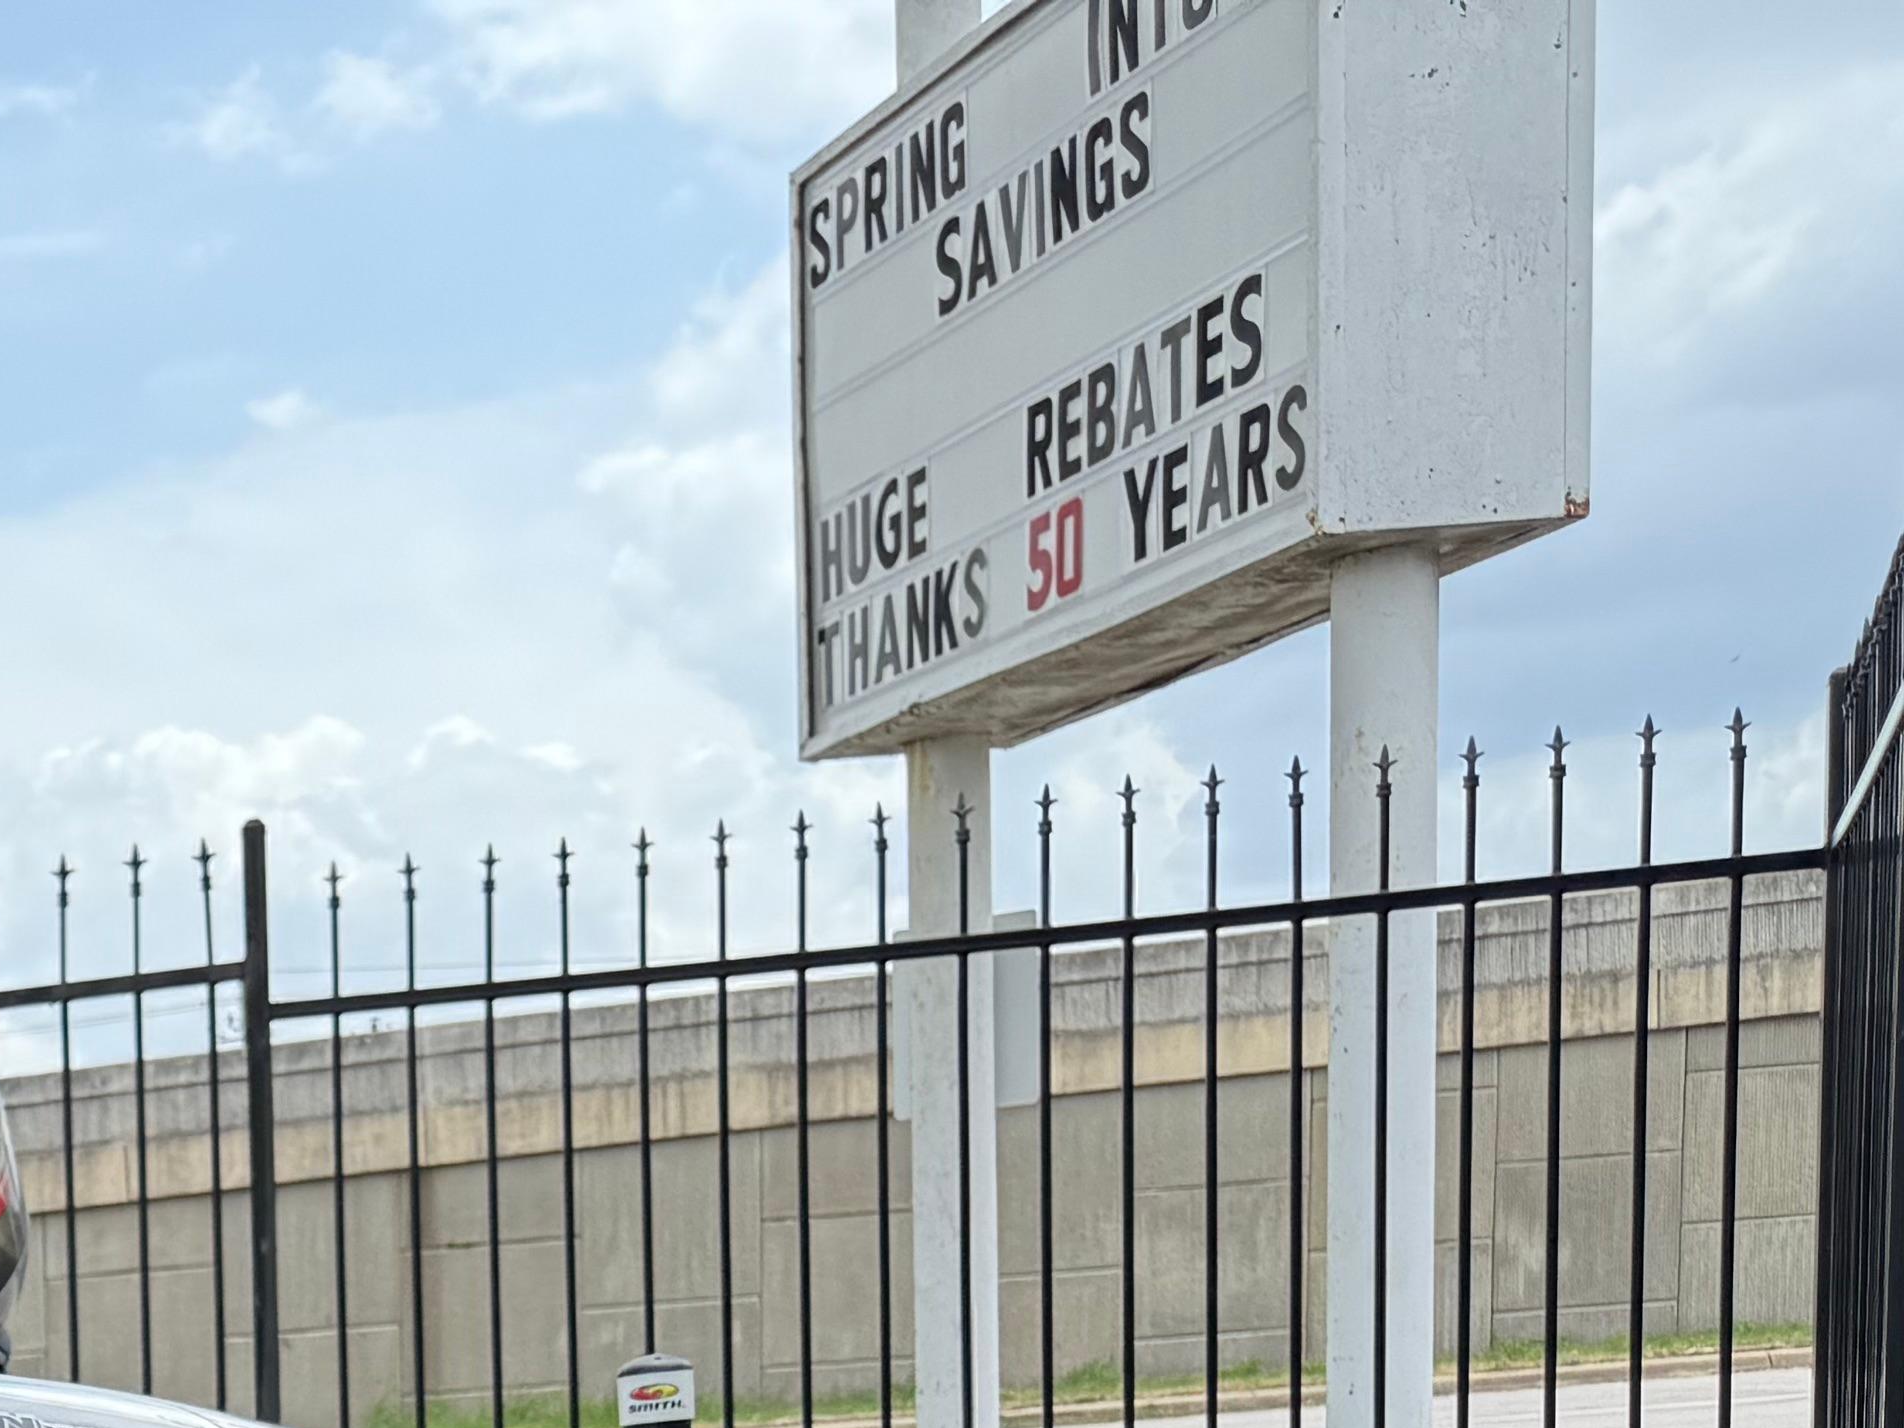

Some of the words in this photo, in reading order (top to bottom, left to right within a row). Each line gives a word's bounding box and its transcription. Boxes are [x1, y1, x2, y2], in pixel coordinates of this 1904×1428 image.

[1088, 0, 1214, 97] IN
[810, 100, 966, 289] SPRING
[936, 90, 1150, 317] SAVINGS
[820, 465, 928, 604] HUGE
[1026, 273, 1262, 499] REBATES
[817, 547, 988, 707] THANKS
[1027, 496, 1084, 612] 50
[1122, 384, 1308, 563] YEARS
[628, 1400, 682, 1415] SMITH
